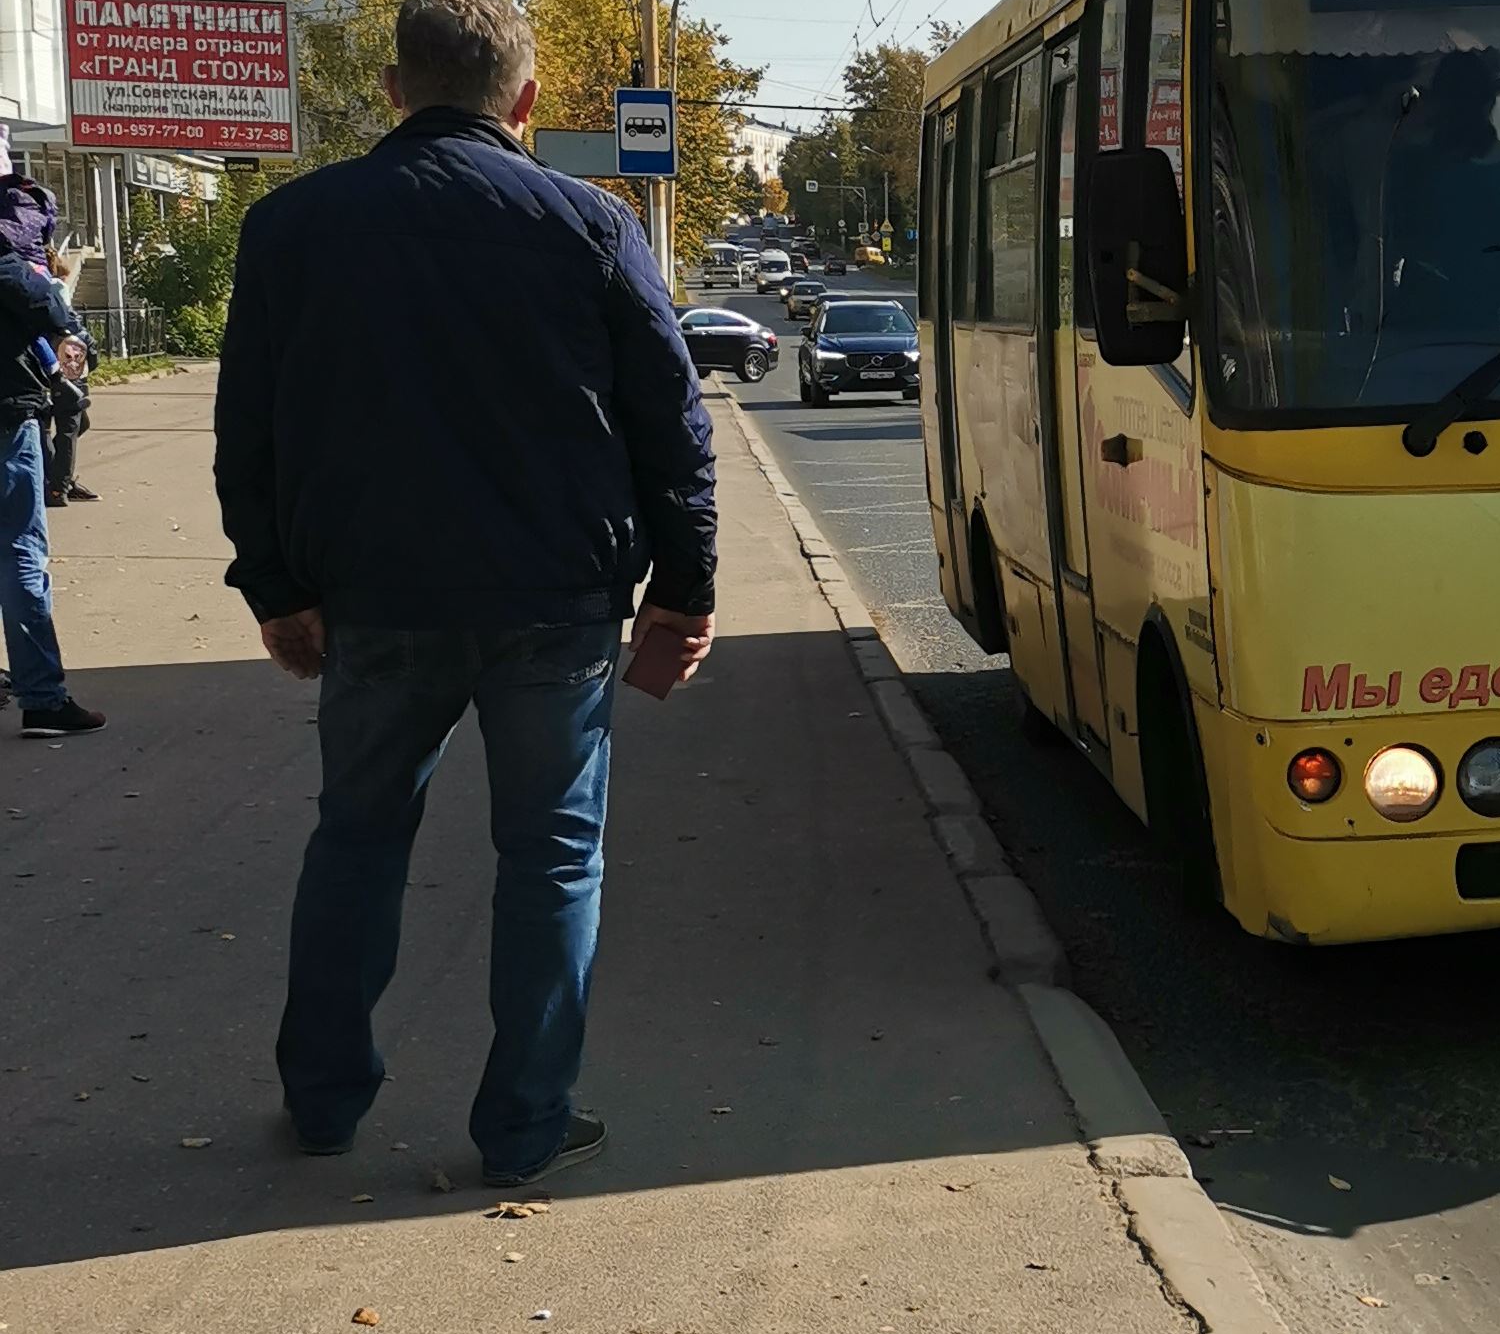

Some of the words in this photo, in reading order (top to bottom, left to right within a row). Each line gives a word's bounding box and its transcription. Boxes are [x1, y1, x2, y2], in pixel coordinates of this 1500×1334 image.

[74, 0, 283, 35] ПАМЯТНИКИ
[76, 32, 99, 47] от
[107, 33, 188, 55] лидера
[195, 38, 282, 57] отрасли
[79, 55, 178, 81] «ГРАНД
[192, 59, 286, 83] СТОУН»
[227, 88, 249, 103] 44
[253, 88, 266, 103] А
[103, 102, 169, 116] (напротив
[173, 104, 191, 116] ТЦ
[1301, 663, 1402, 713] Мы
